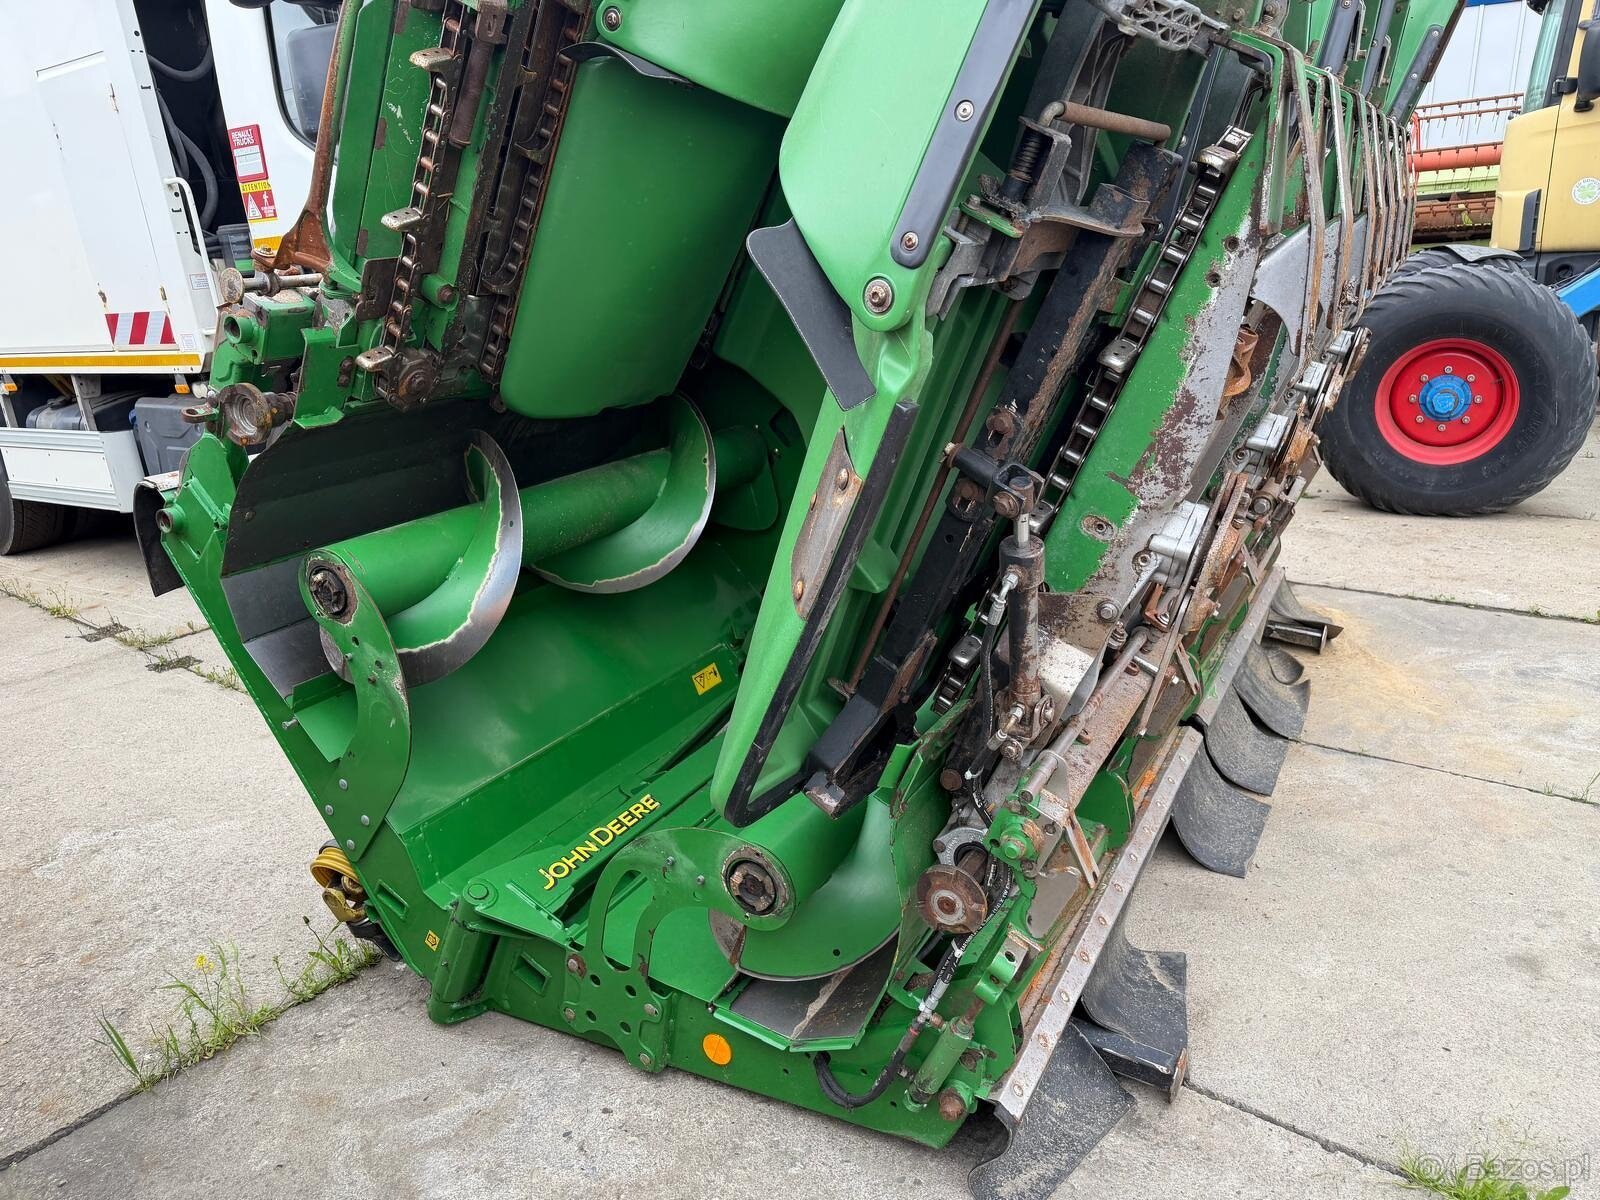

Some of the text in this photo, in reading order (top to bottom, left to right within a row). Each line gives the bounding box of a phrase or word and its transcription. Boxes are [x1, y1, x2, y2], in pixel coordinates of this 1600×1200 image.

[231, 128, 253, 140] RENAULT
[233, 136, 255, 147] TRUCKS
[241, 181, 271, 191] ATTENTION
[538, 793, 660, 890] JOHN DEERE
